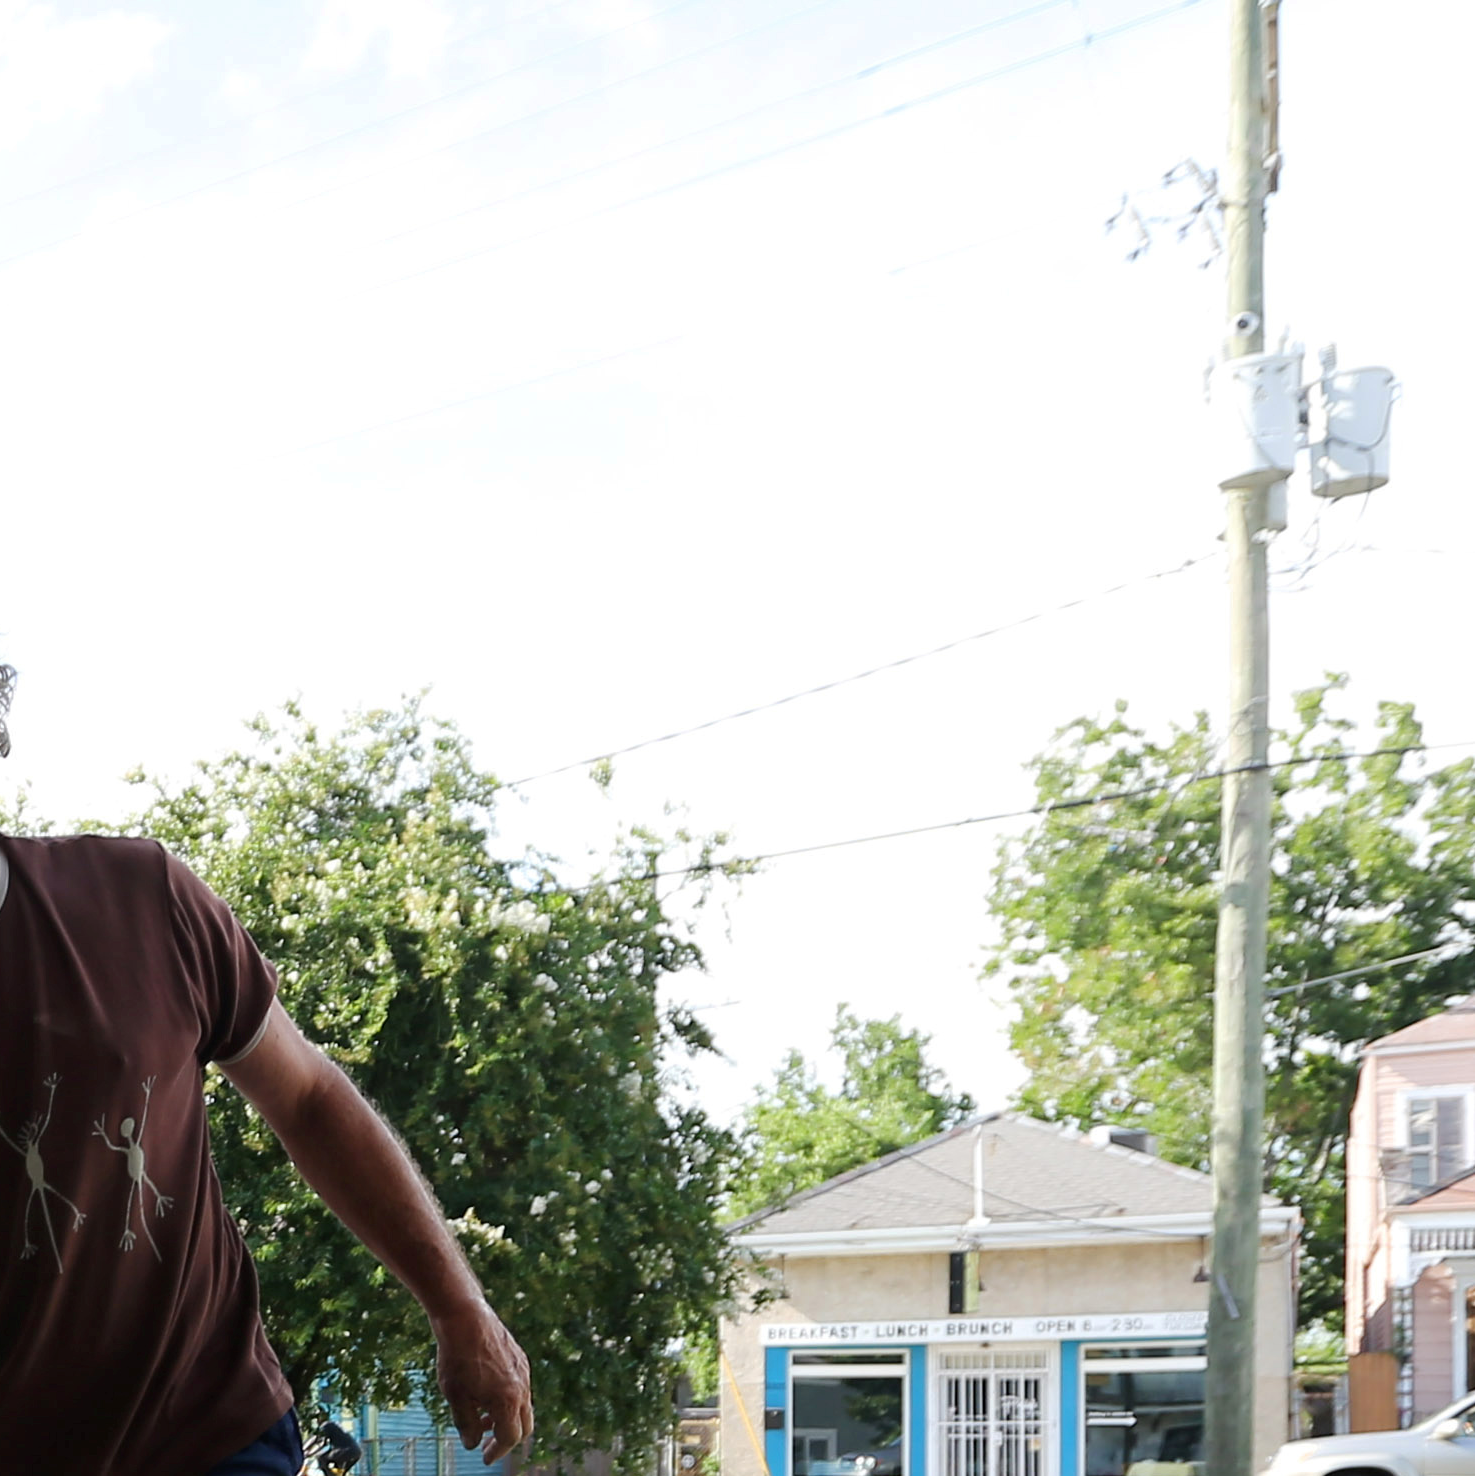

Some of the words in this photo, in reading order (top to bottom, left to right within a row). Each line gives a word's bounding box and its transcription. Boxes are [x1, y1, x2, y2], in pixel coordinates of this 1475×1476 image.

[768, 1325, 859, 1340] BREAKFAST
[876, 1323, 929, 1338] LUNCH
[946, 1321, 1013, 1336] BRUNCH
[1035, 1319, 1076, 1333] OPEN
